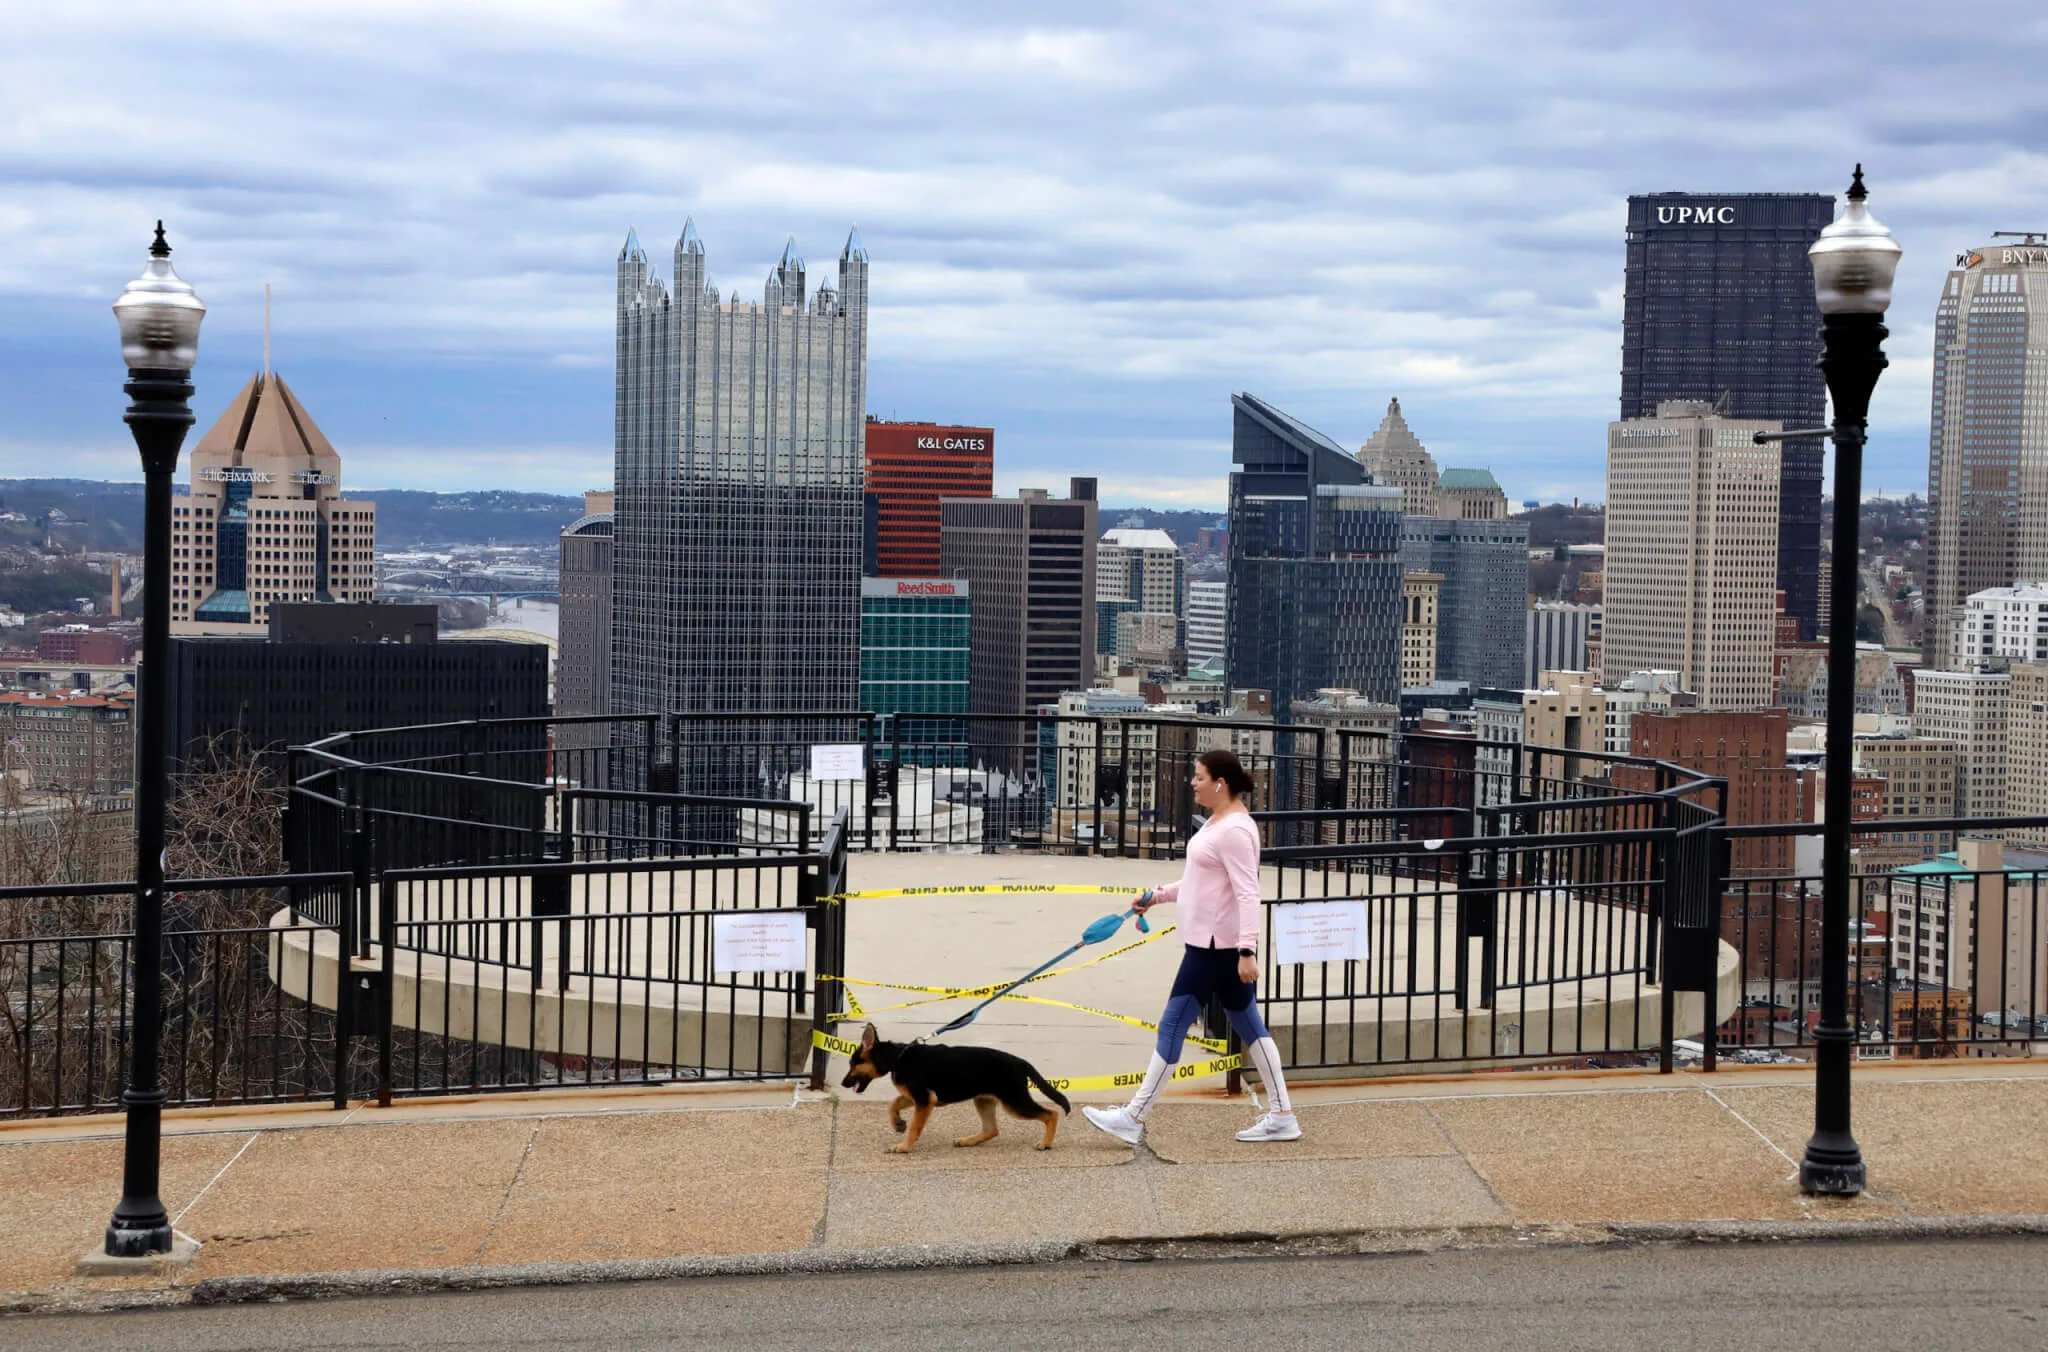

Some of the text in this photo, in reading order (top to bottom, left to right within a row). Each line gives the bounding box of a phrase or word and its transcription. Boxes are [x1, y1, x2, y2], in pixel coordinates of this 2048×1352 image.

[1657, 207, 1734, 224] UPMC
[2002, 249, 2036, 264] BNY
[918, 437, 985, 450] K&L GATES
[206, 470, 270, 483] HIGHMARK
[897, 581, 956, 595] Reed Smith
[824, 1037, 857, 1055] UTION
[1209, 1055, 1242, 1073] UTION
[1179, 1065, 1195, 1078] DO
[1114, 1072, 1148, 1086] NTER
